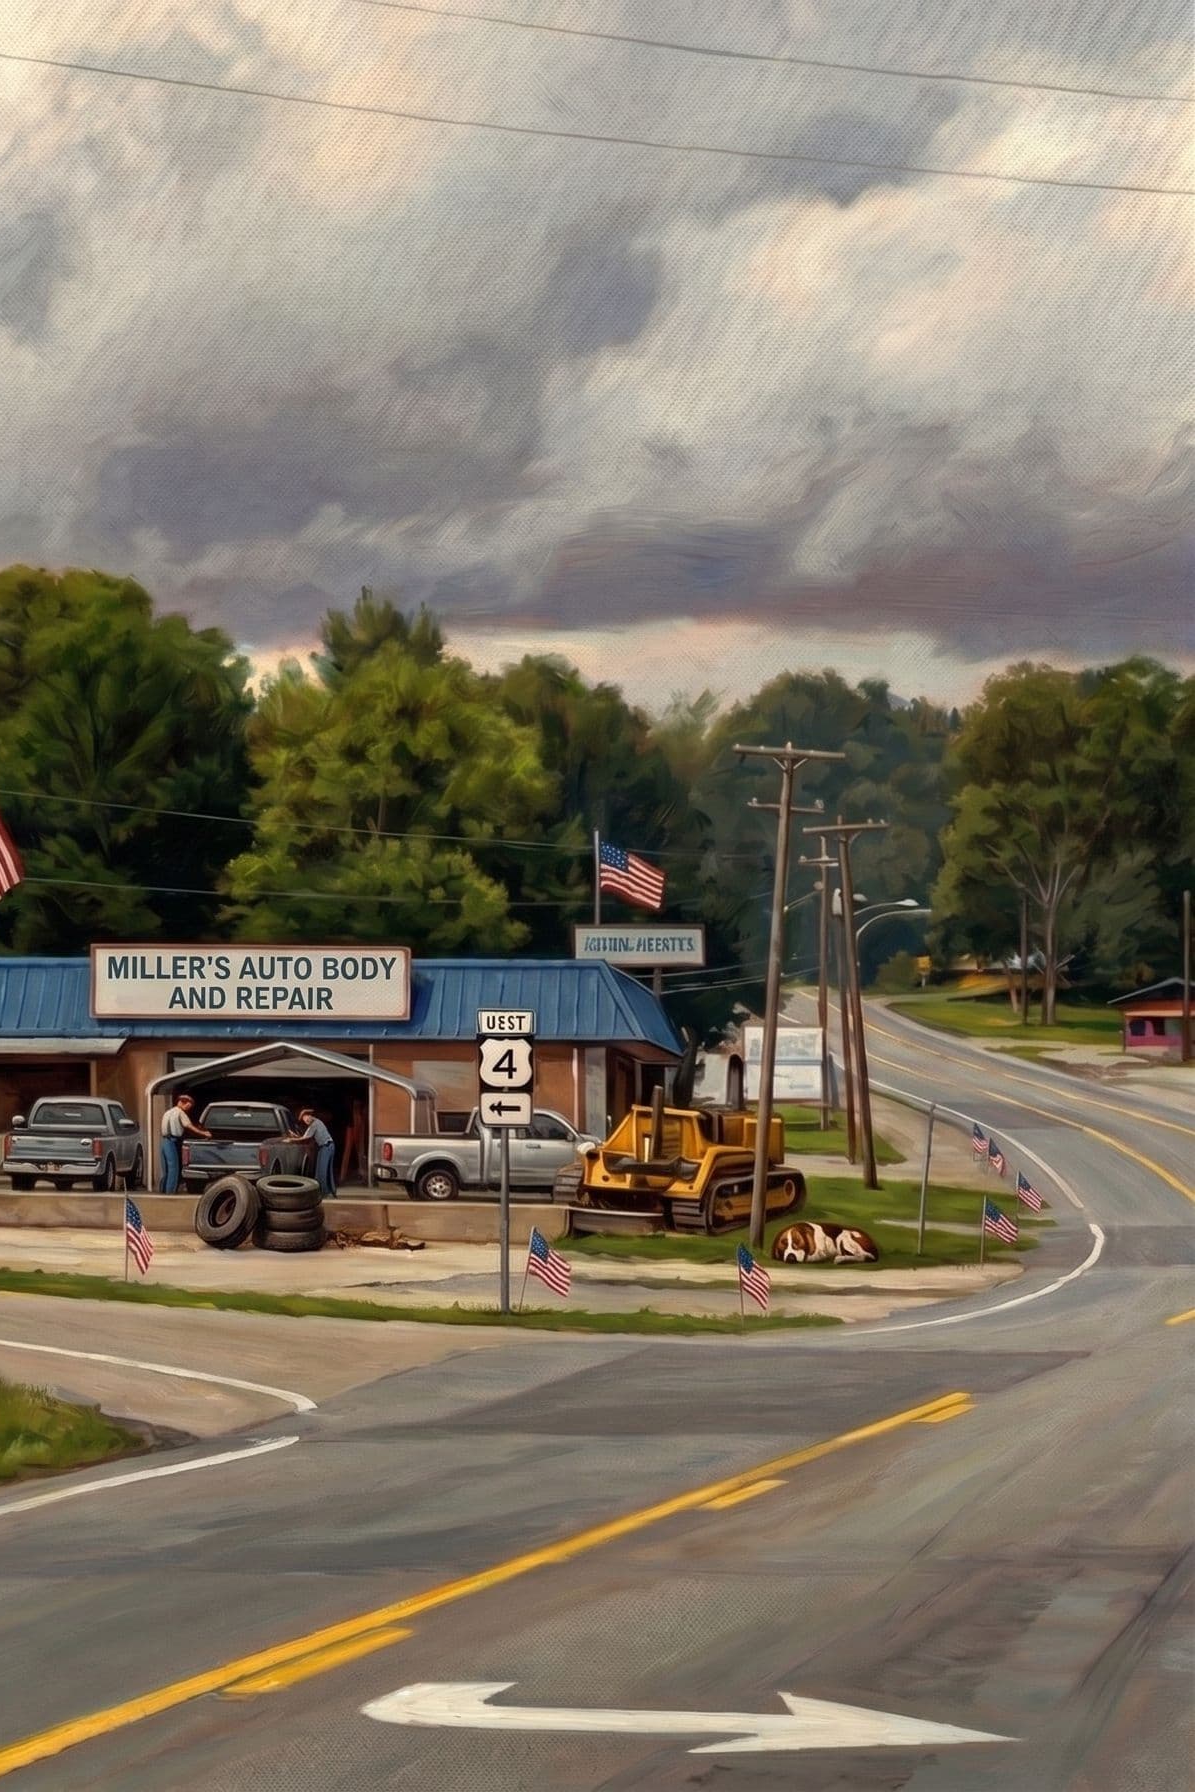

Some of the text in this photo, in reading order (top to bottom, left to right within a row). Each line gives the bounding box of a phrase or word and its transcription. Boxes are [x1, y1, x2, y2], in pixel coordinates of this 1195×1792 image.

[107, 956, 398, 981] MILLER'S AUTO BODY
[168, 986, 334, 1011] AND REPAIR
[492, 1048, 517, 1080] 4
